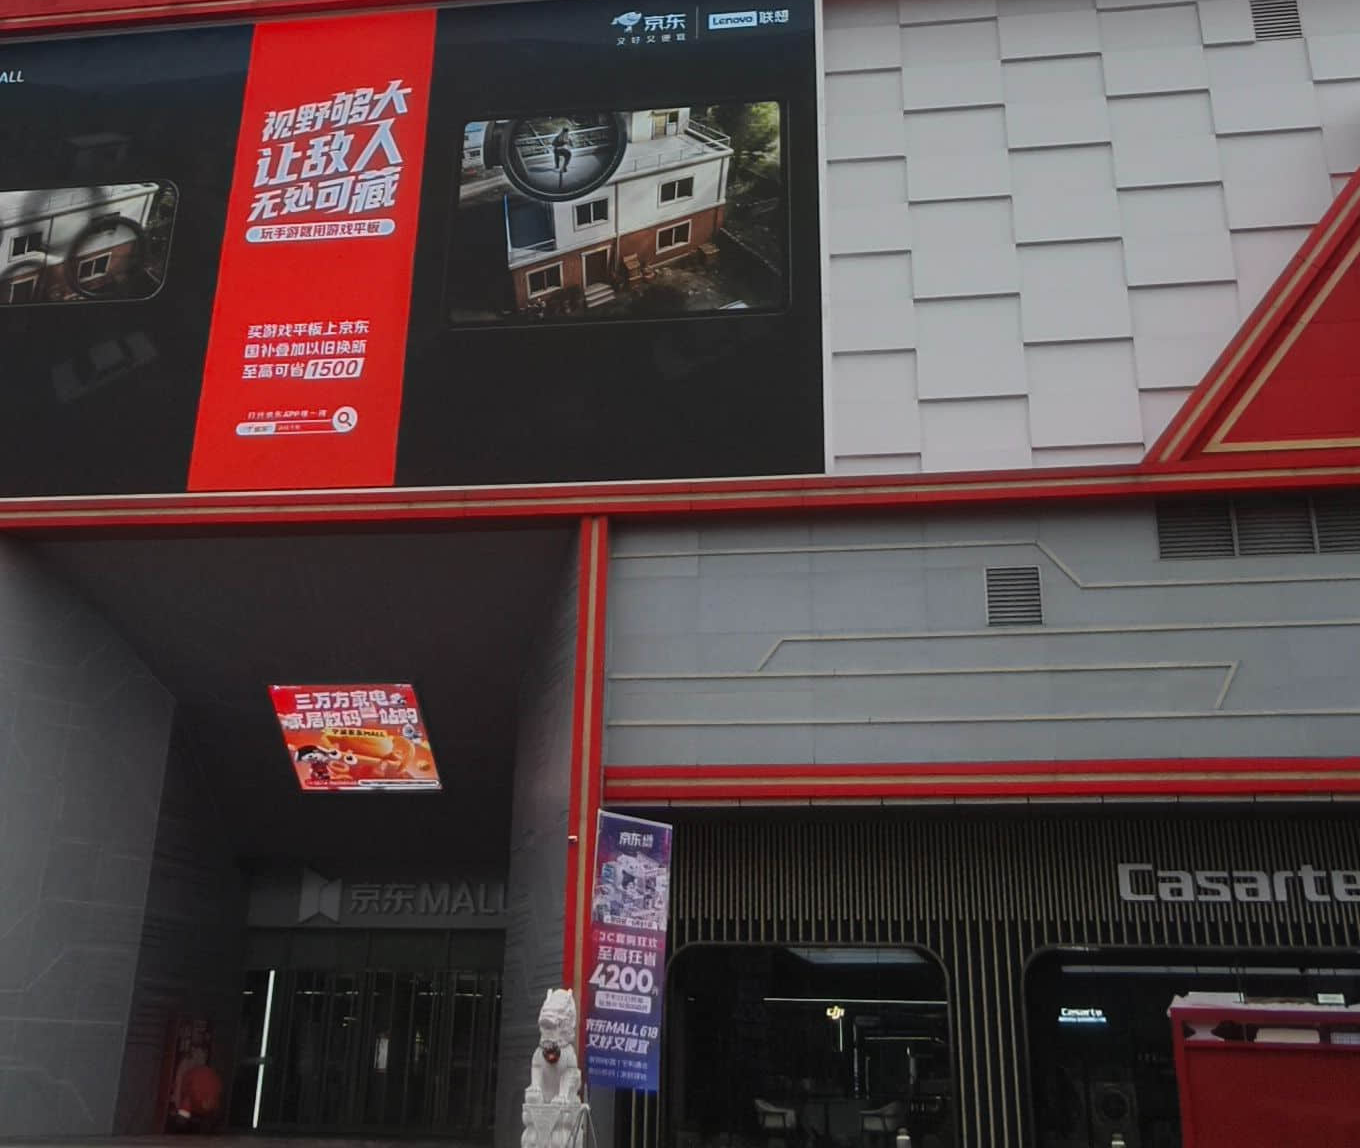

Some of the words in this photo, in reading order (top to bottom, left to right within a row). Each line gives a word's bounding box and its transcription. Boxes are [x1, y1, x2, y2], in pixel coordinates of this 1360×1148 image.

[644, 13, 687, 31] 京东
[711, 14, 754, 27] Lenovo
[759, 9, 790, 24] 联想
[616, 33, 686, 46] 又好又便宜
[261, 79, 412, 142] 视野够大
[253, 118, 404, 188] 让敌人
[247, 166, 403, 222] 无处可藏
[247, 320, 370, 339] 买游戏平板上京东
[244, 340, 367, 358] 国补叠加以旧换新
[241, 359, 360, 379] 至高可省1500
